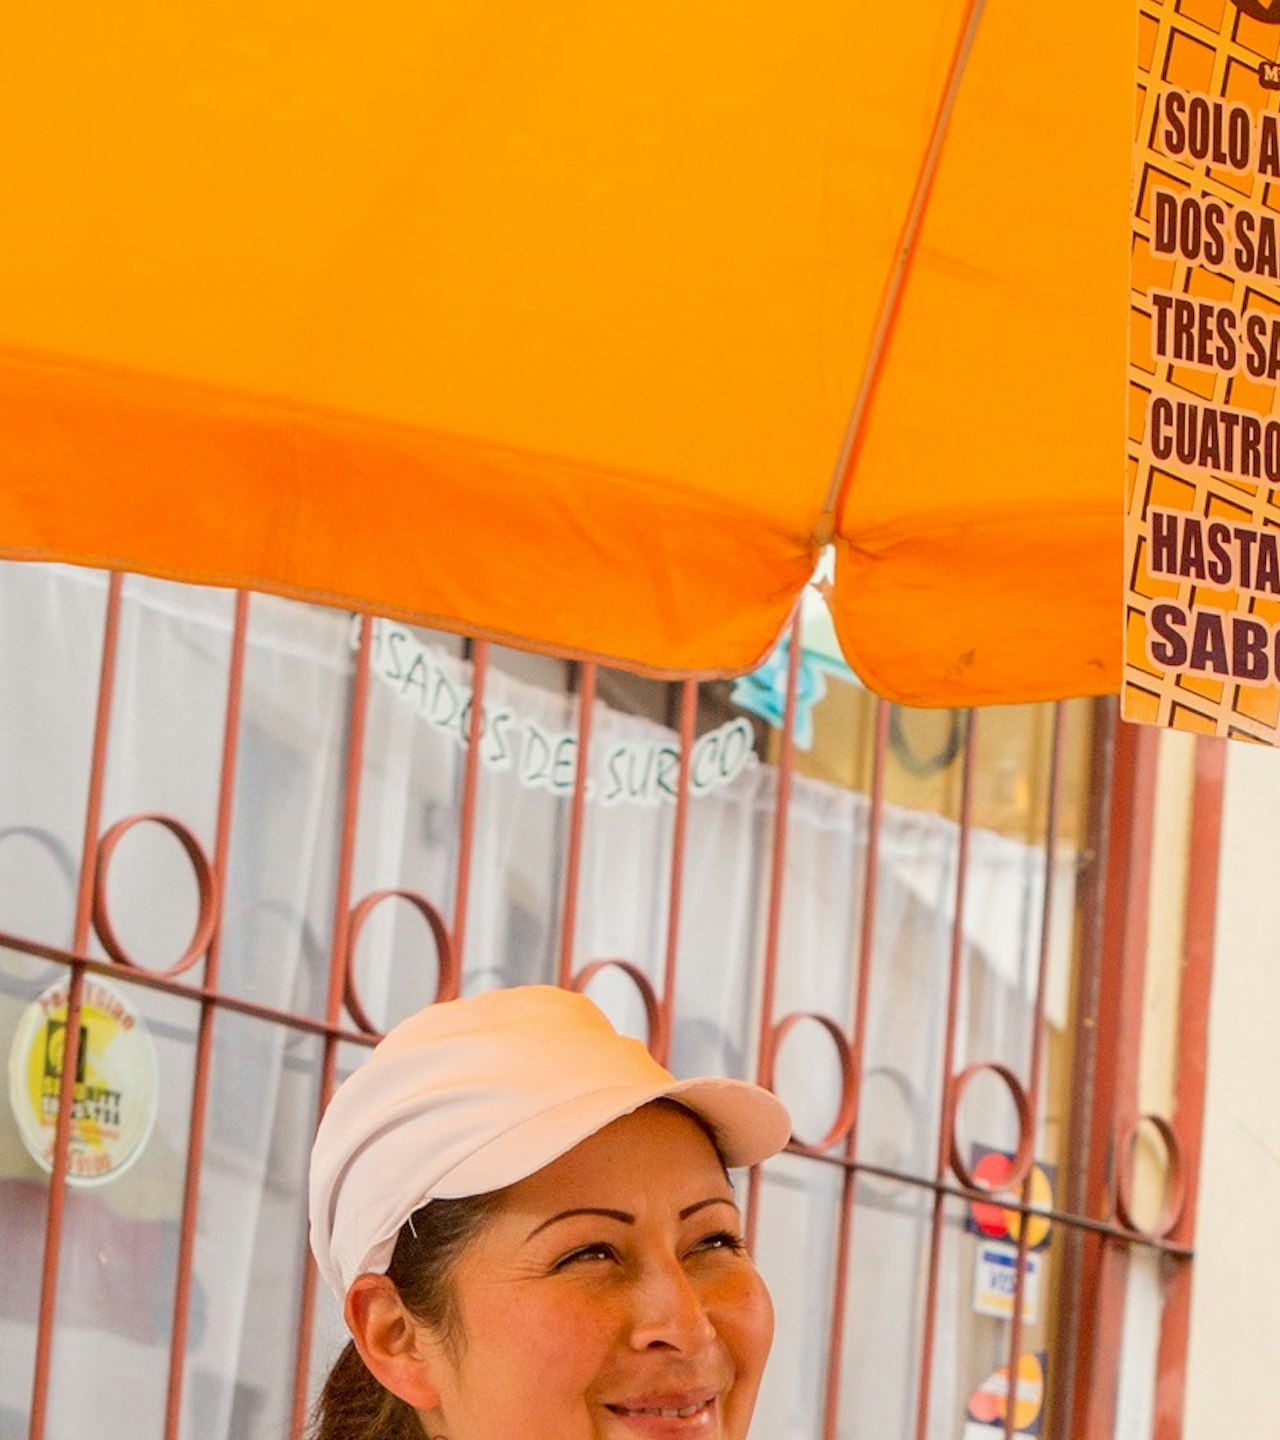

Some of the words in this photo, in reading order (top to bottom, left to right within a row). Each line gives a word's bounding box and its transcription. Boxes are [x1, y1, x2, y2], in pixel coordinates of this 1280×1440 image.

[1164, 92, 1249, 169] SOLO
[1155, 191, 1224, 265] DOS
[1152, 294, 1236, 371] TRES
[1151, 512, 1280, 596] HASTA
[527, 724, 587, 791] DE
